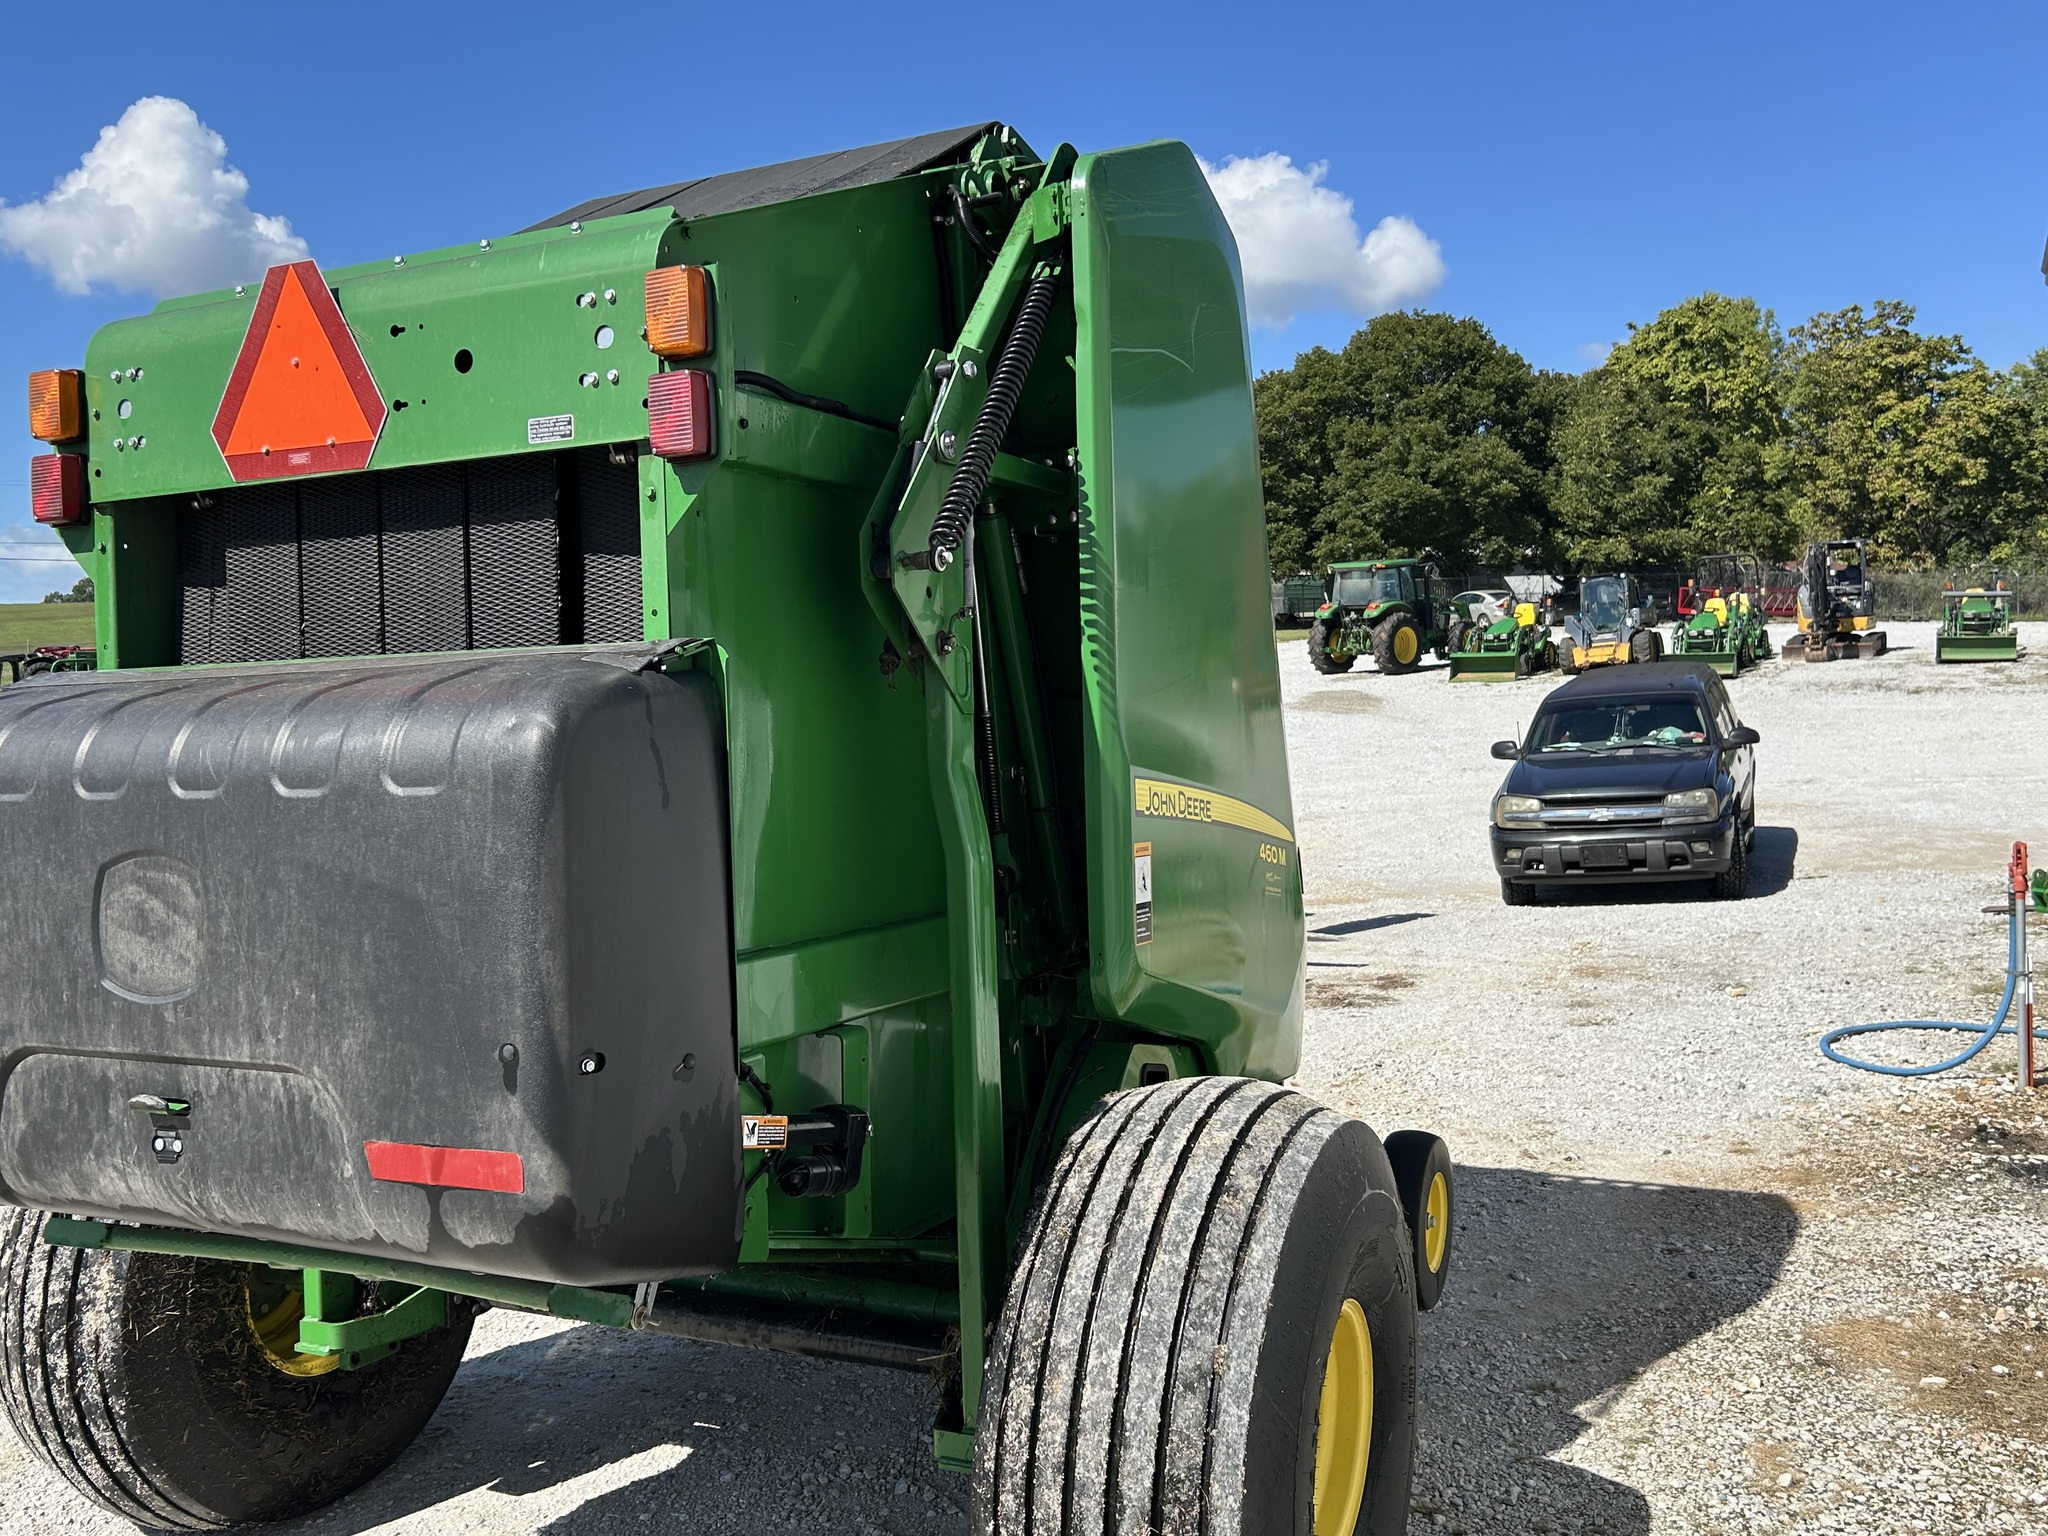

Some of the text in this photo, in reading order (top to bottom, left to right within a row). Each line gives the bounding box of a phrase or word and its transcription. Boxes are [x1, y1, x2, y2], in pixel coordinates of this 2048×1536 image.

[1145, 786, 1212, 819] JOHN DEERE
[1259, 842, 1287, 866] 460 M
